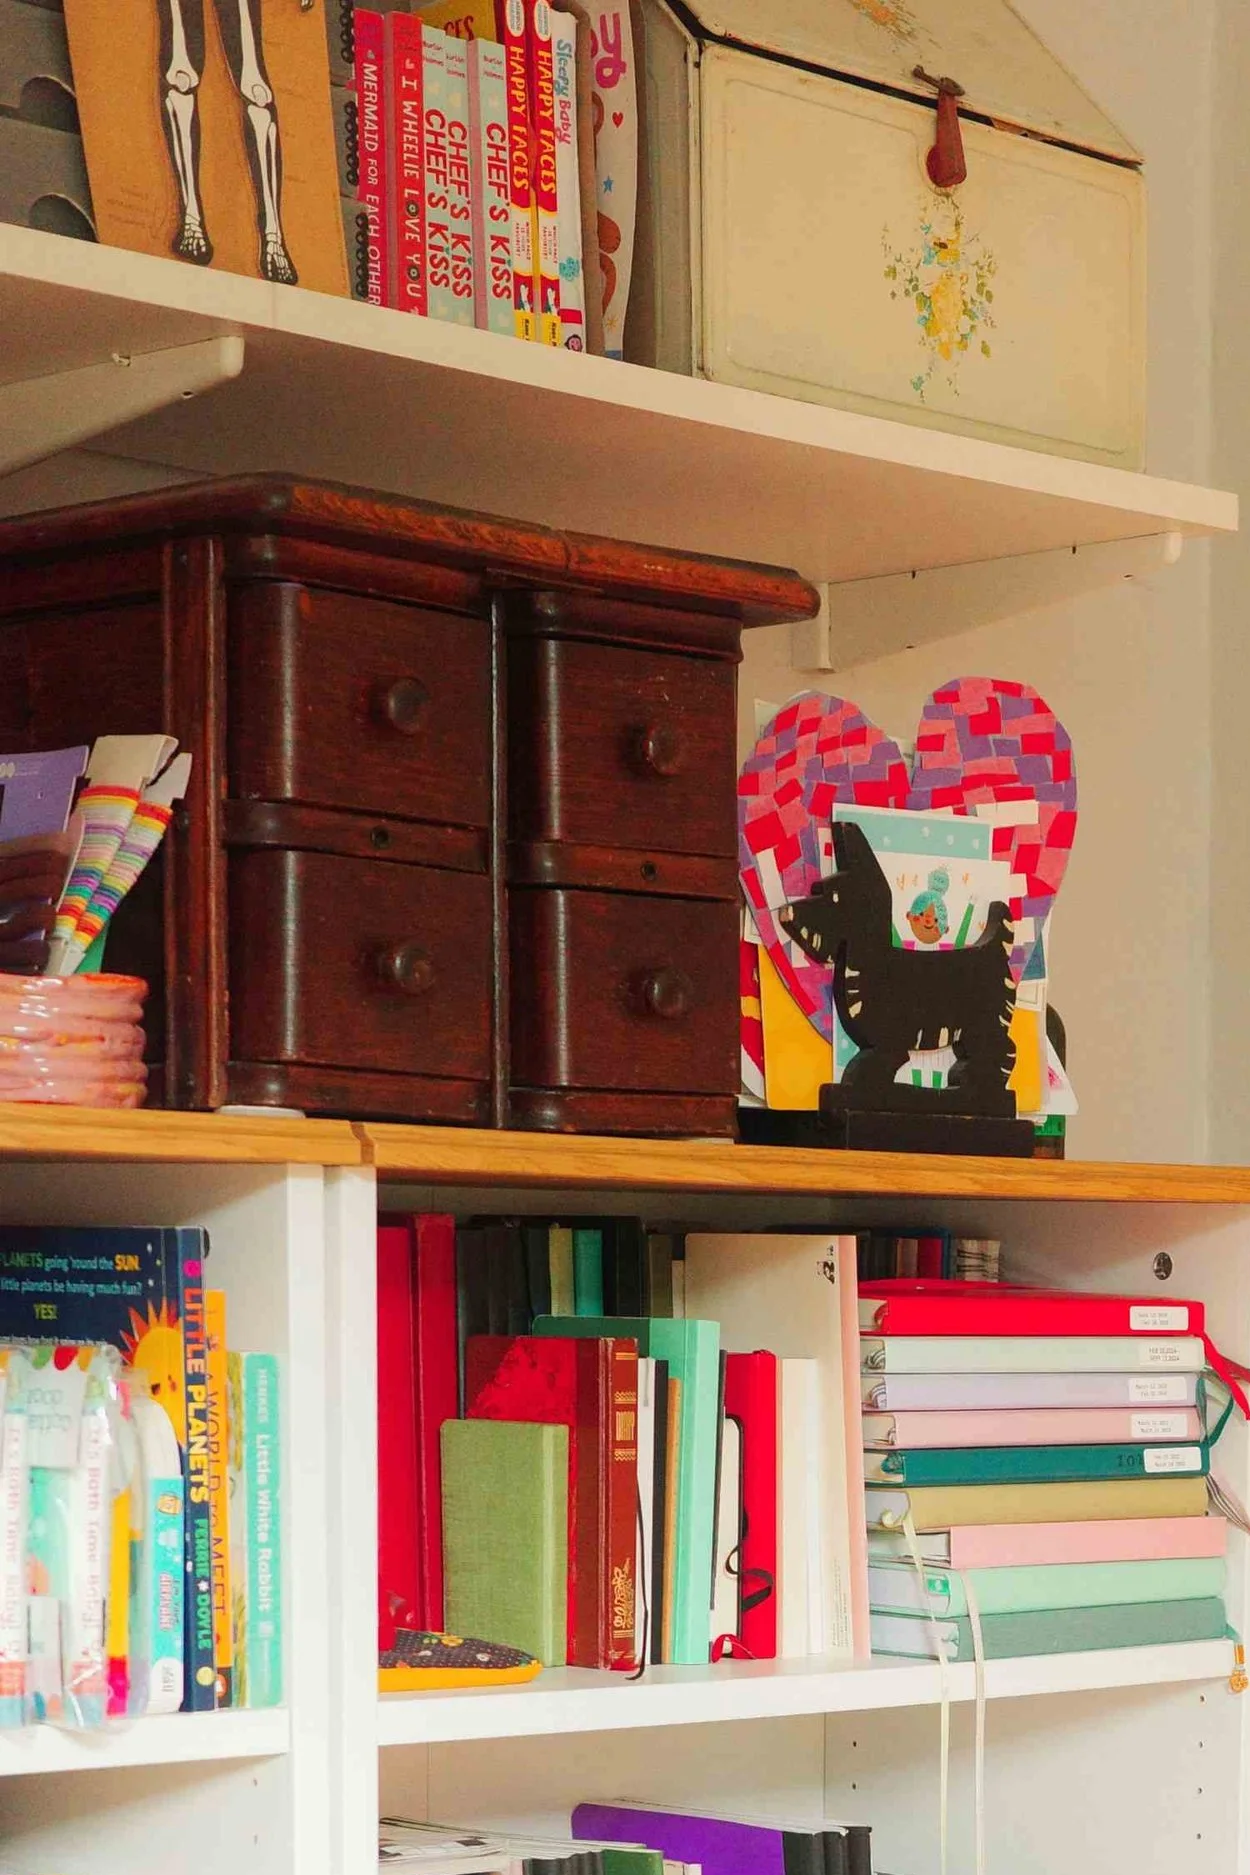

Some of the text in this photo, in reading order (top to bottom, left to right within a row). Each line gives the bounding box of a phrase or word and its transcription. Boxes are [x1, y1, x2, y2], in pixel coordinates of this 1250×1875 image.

[509, 46, 526, 118] HAPPY
[537, 50, 554, 122] HAPPY
[363, 63, 381, 305] MERMAID FOR EACH OTHER
[402, 76, 422, 298] I WHEELIE LOVE YOU
[511, 125, 529, 190] FACES
[540, 129, 556, 194] FACES
[425, 109, 450, 288] CHEF'S KISS
[448, 120, 473, 299] CHEF'S KISS
[490, 234, 512, 300] KISS
[184, 1288, 210, 1504] LITTLE PLANETS
[258, 1547, 274, 1613] Rabbit
[196, 1594, 213, 1650] DOYLE
